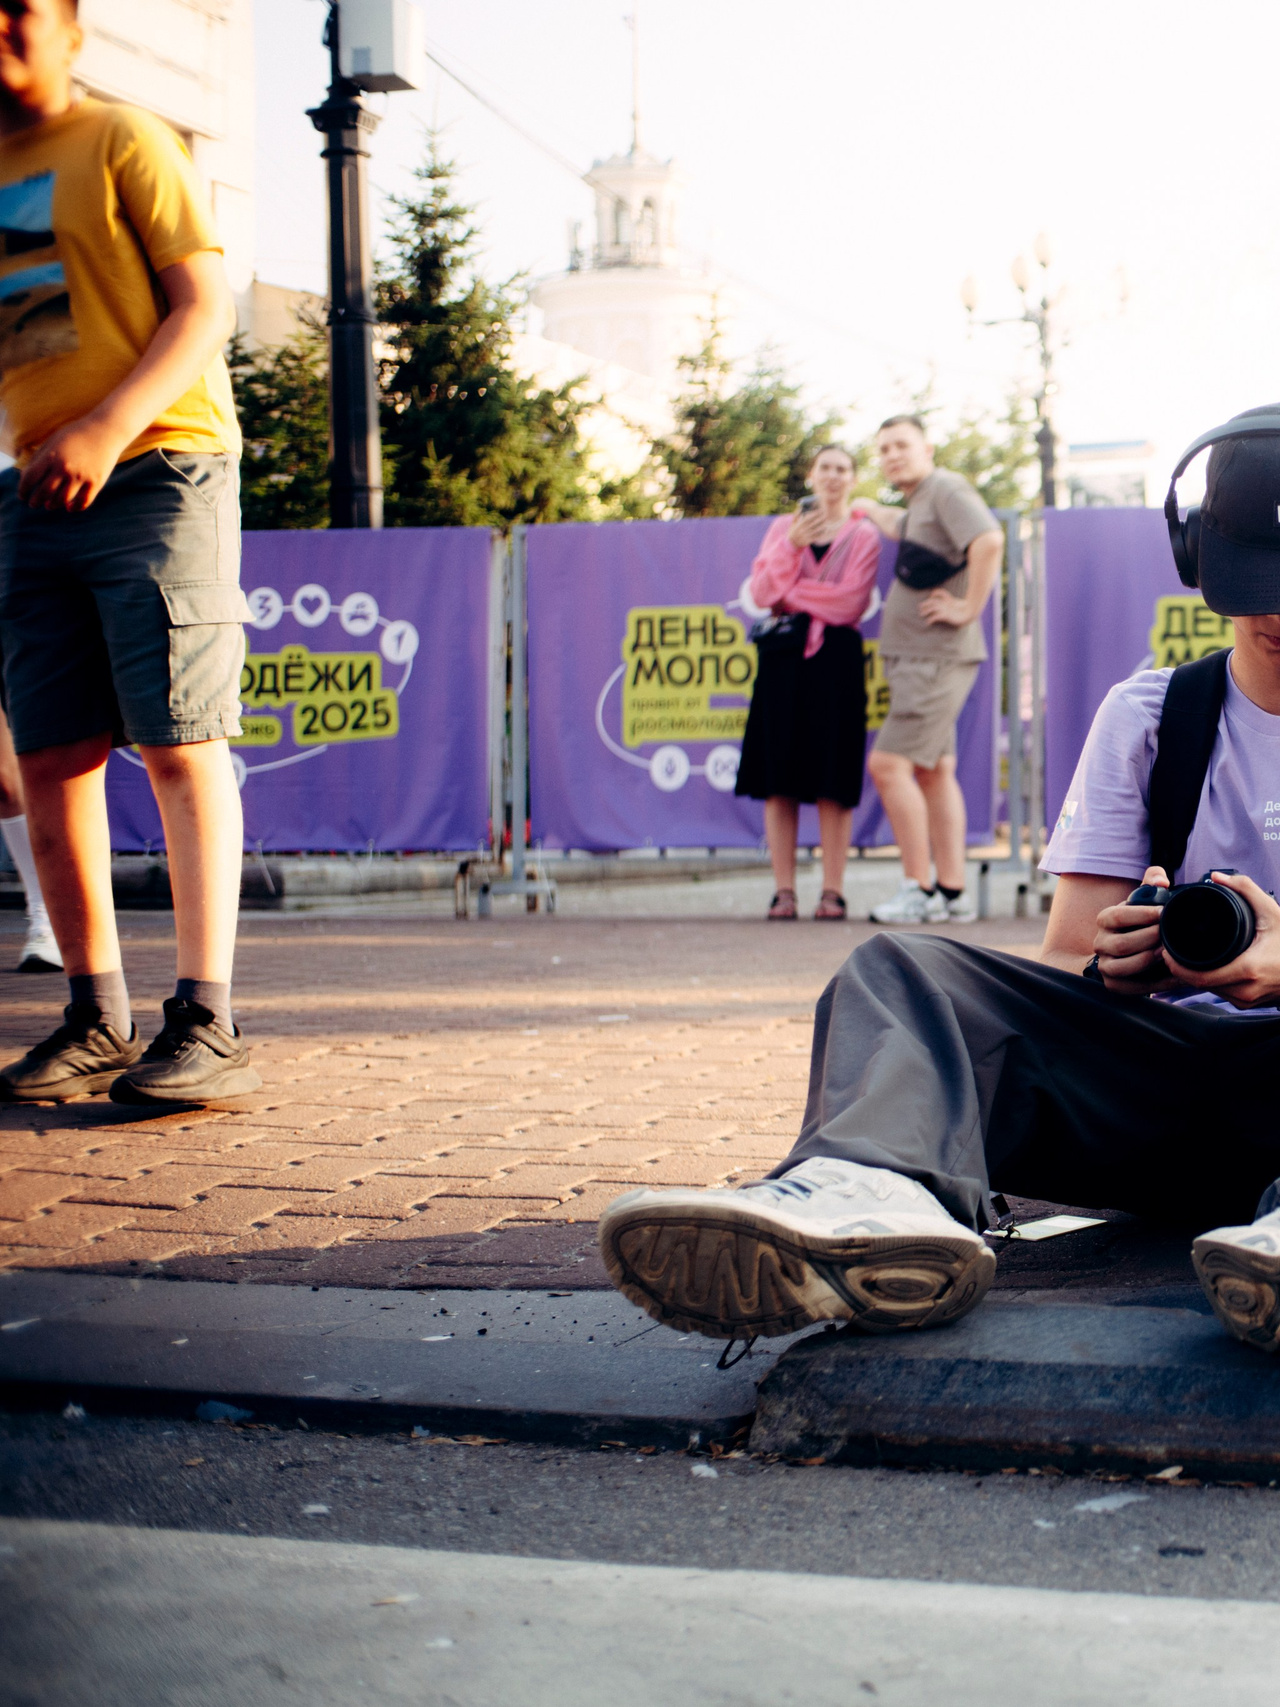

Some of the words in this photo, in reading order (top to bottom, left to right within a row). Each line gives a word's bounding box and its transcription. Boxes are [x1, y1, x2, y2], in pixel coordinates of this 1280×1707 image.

[631, 614, 737, 653] ДЕНЬ
[240, 654, 373, 698] ОДЁЖИ
[632, 653, 752, 688] МОЛО
[302, 697, 391, 736] 2025
